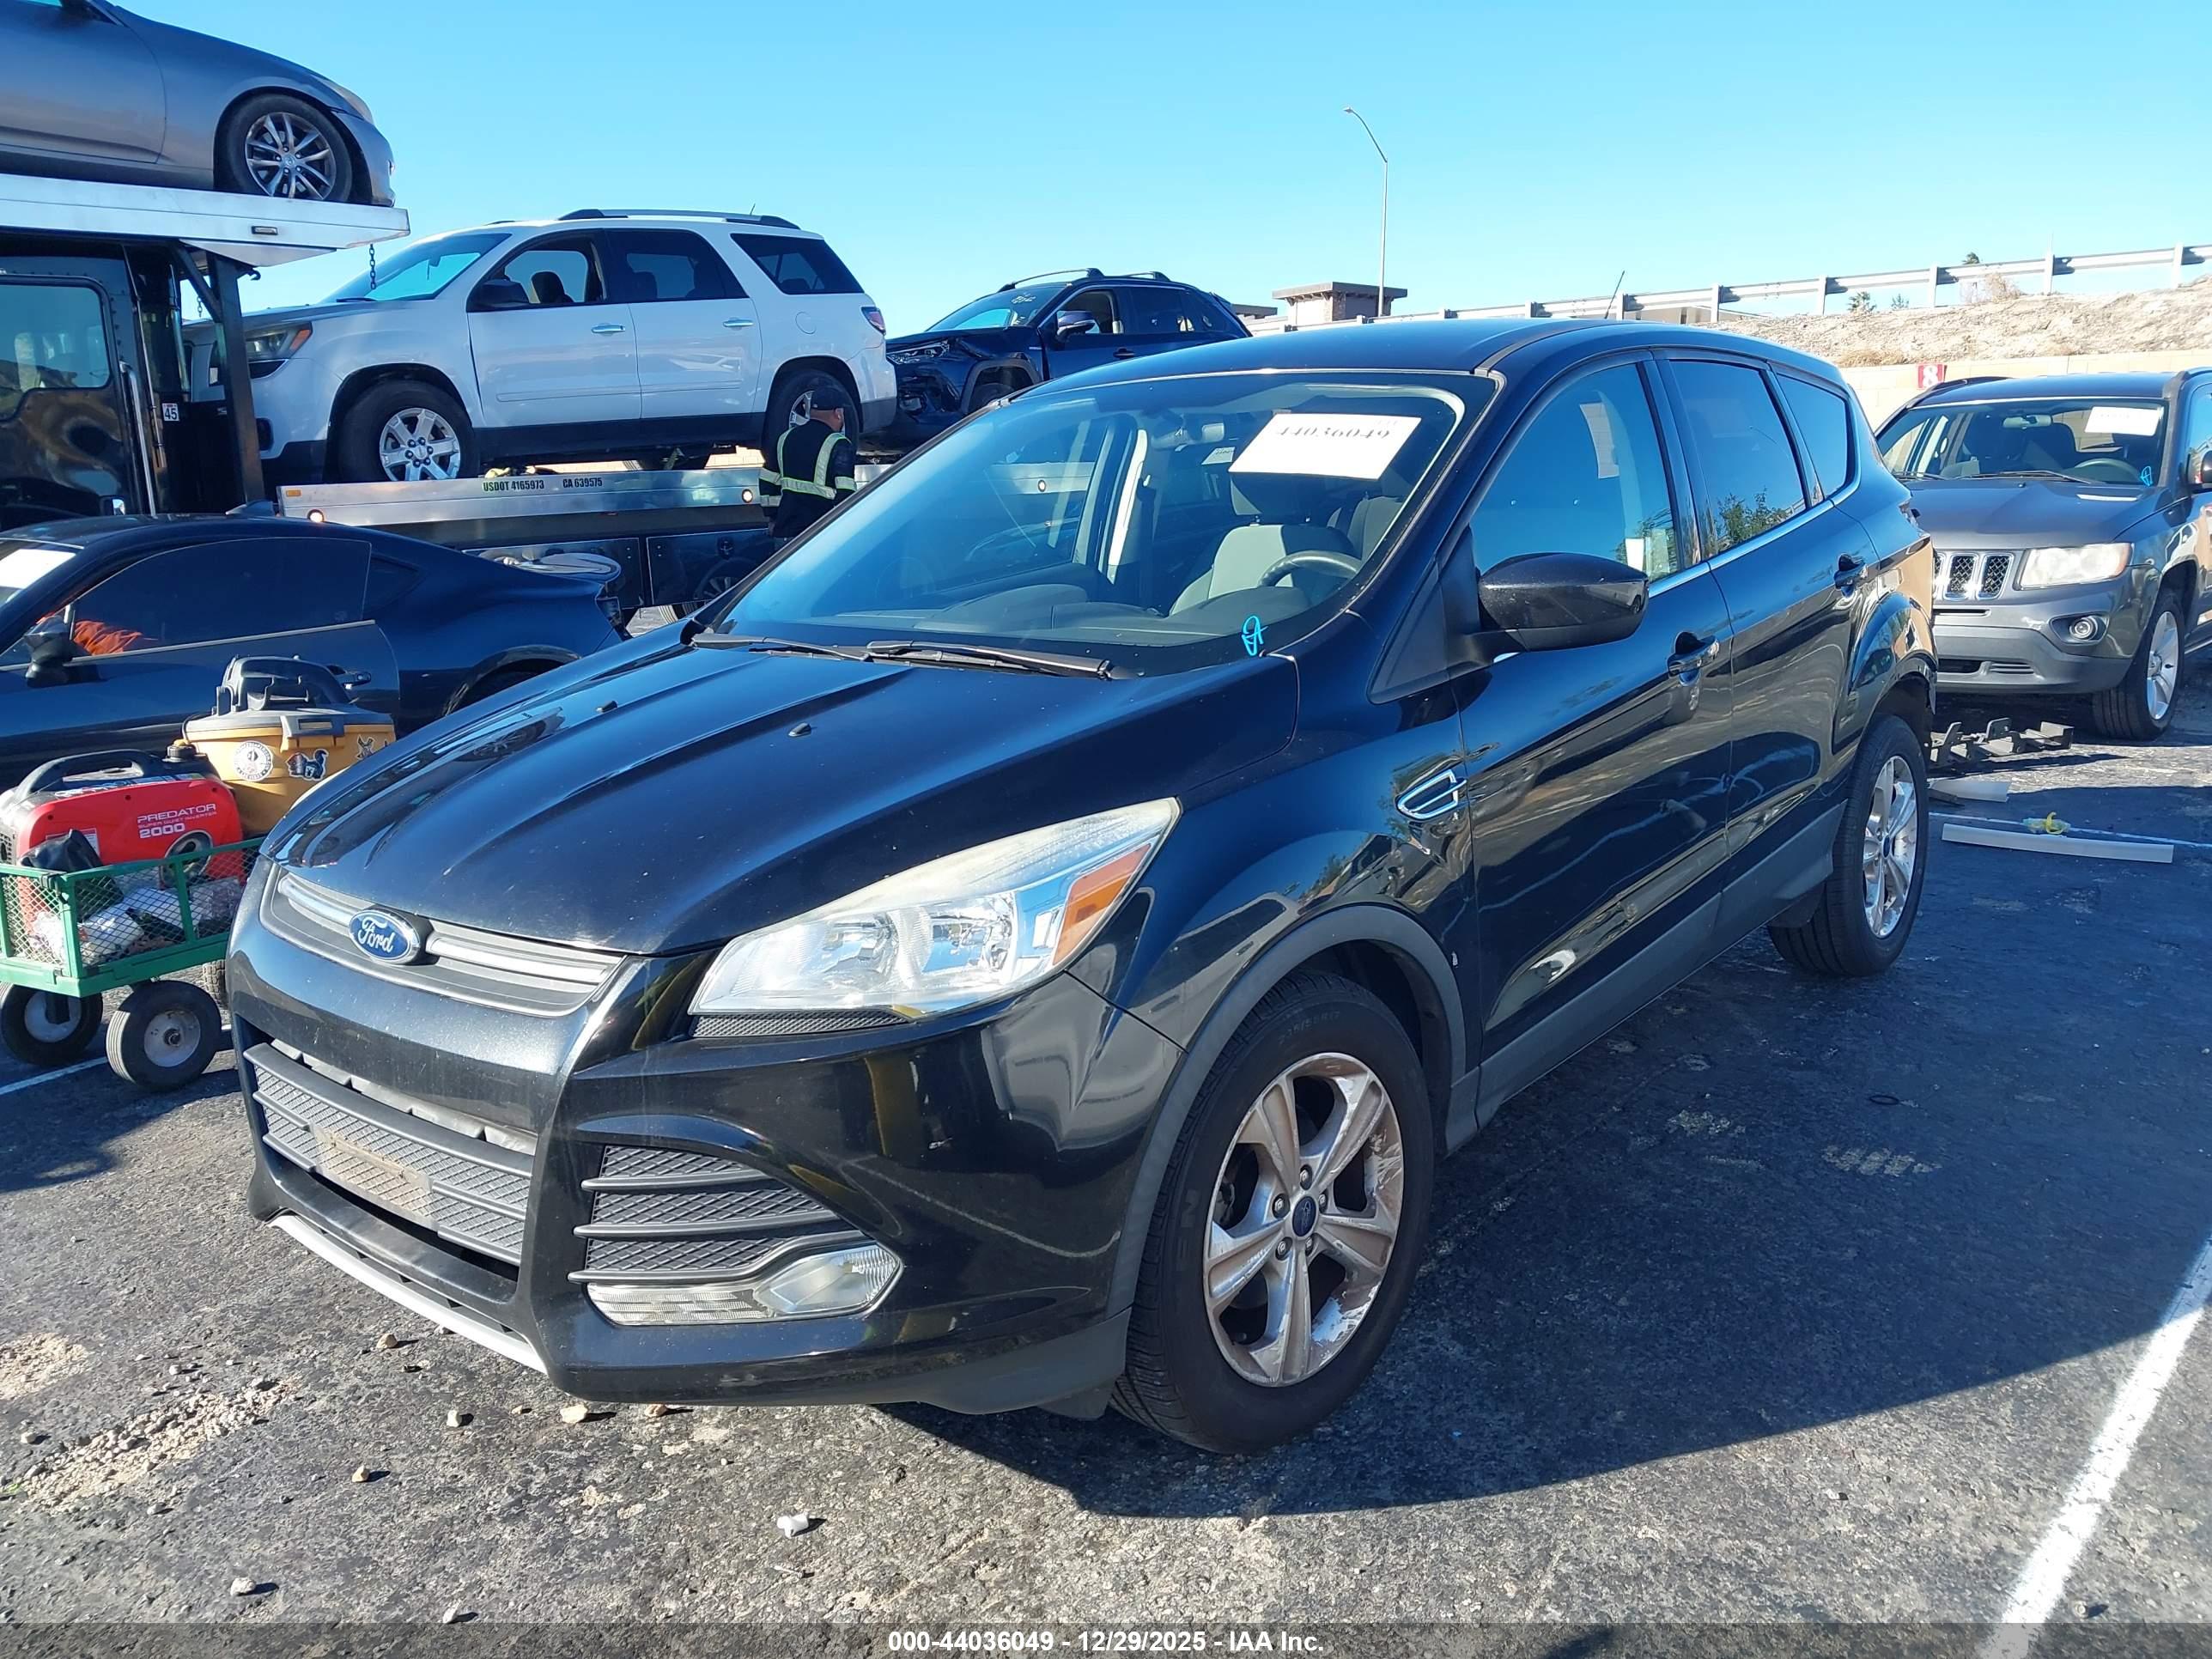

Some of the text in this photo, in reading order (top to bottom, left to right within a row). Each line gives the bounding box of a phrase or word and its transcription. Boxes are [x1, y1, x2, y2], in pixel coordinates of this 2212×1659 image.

[1923, 365, 1938, 386] 8
[165, 407, 178, 420] 45
[483, 479, 545, 492] USDOT 4165973
[562, 477, 603, 489] CA 639575
[137, 804, 216, 823] PREDATOR
[139, 823, 185, 839] 2000
[357, 916, 396, 953] Ford
